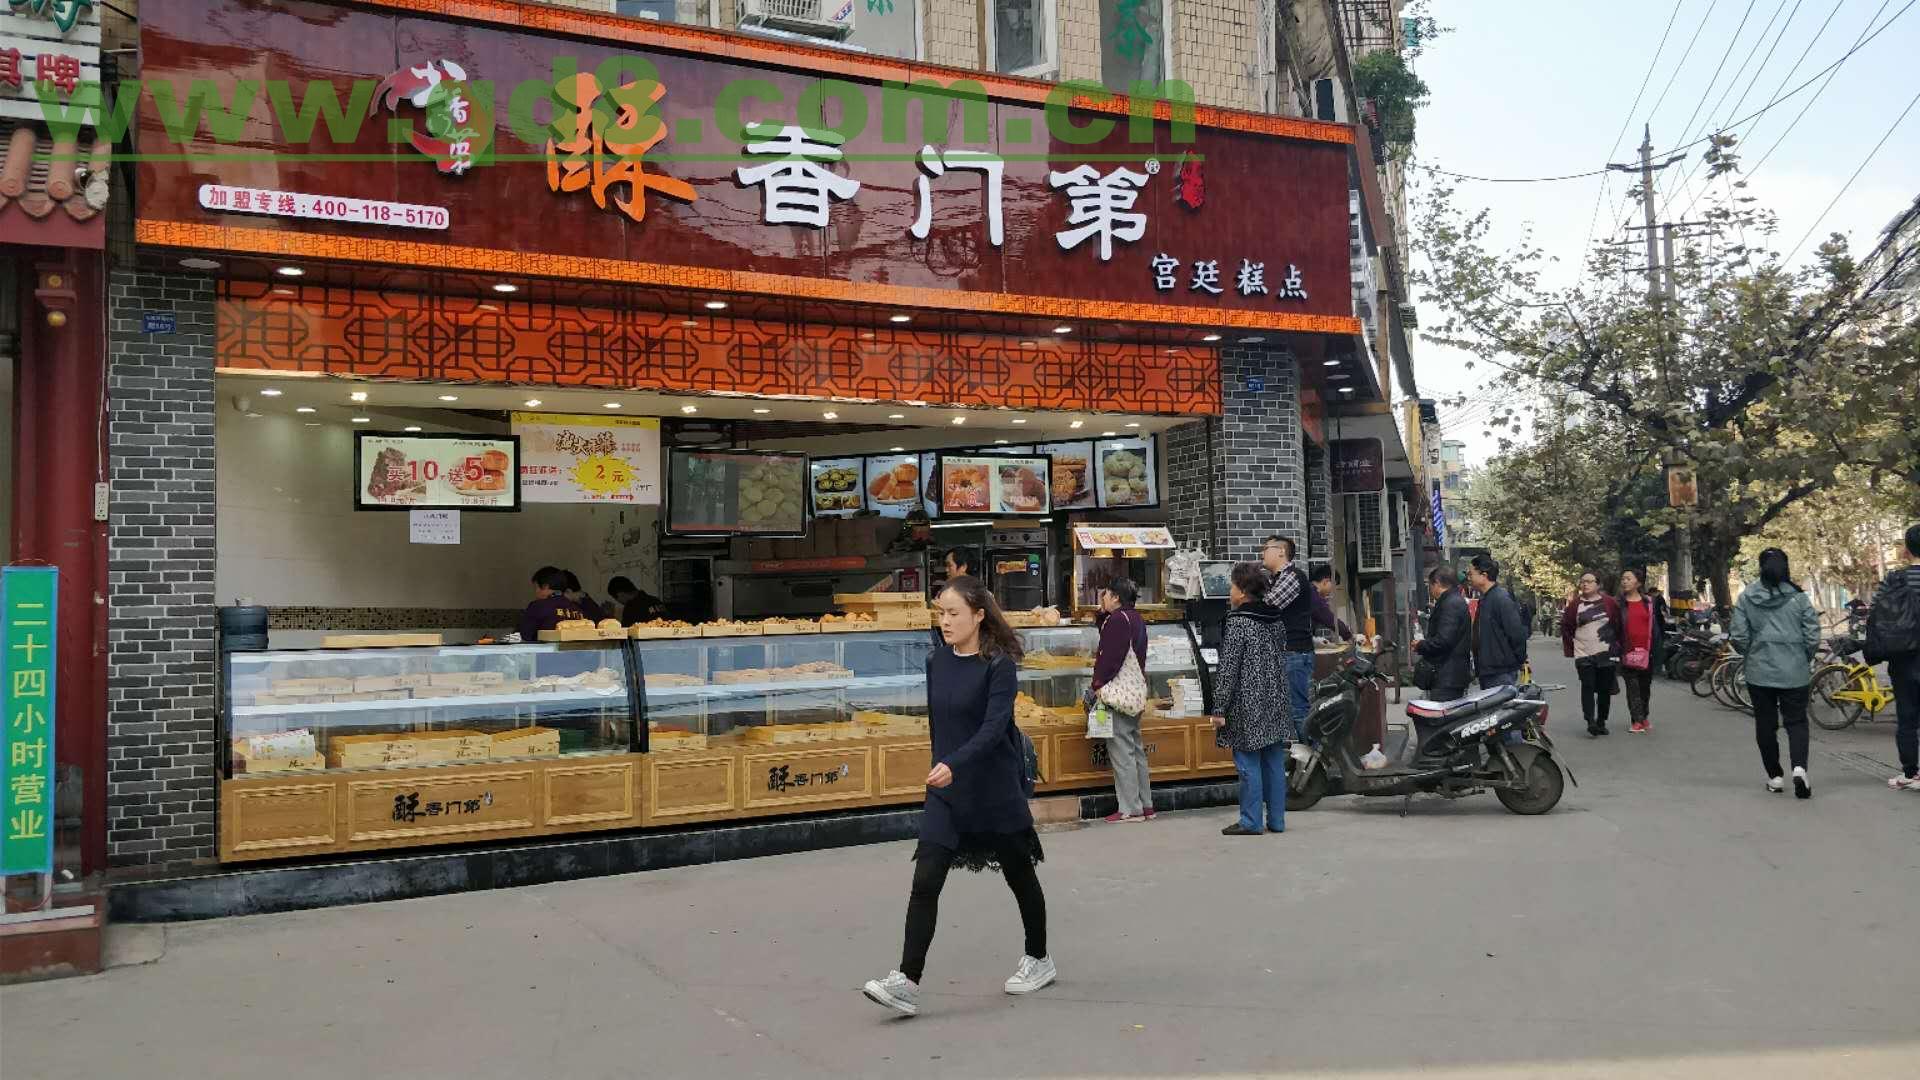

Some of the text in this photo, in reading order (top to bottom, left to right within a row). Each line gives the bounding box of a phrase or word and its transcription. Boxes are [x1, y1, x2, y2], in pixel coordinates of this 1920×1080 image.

[547, 72, 1150, 262] 酥香门第
[1152, 253, 1308, 300] 宫廷糕点
[9, 603, 48, 840] 二十四小时营业
